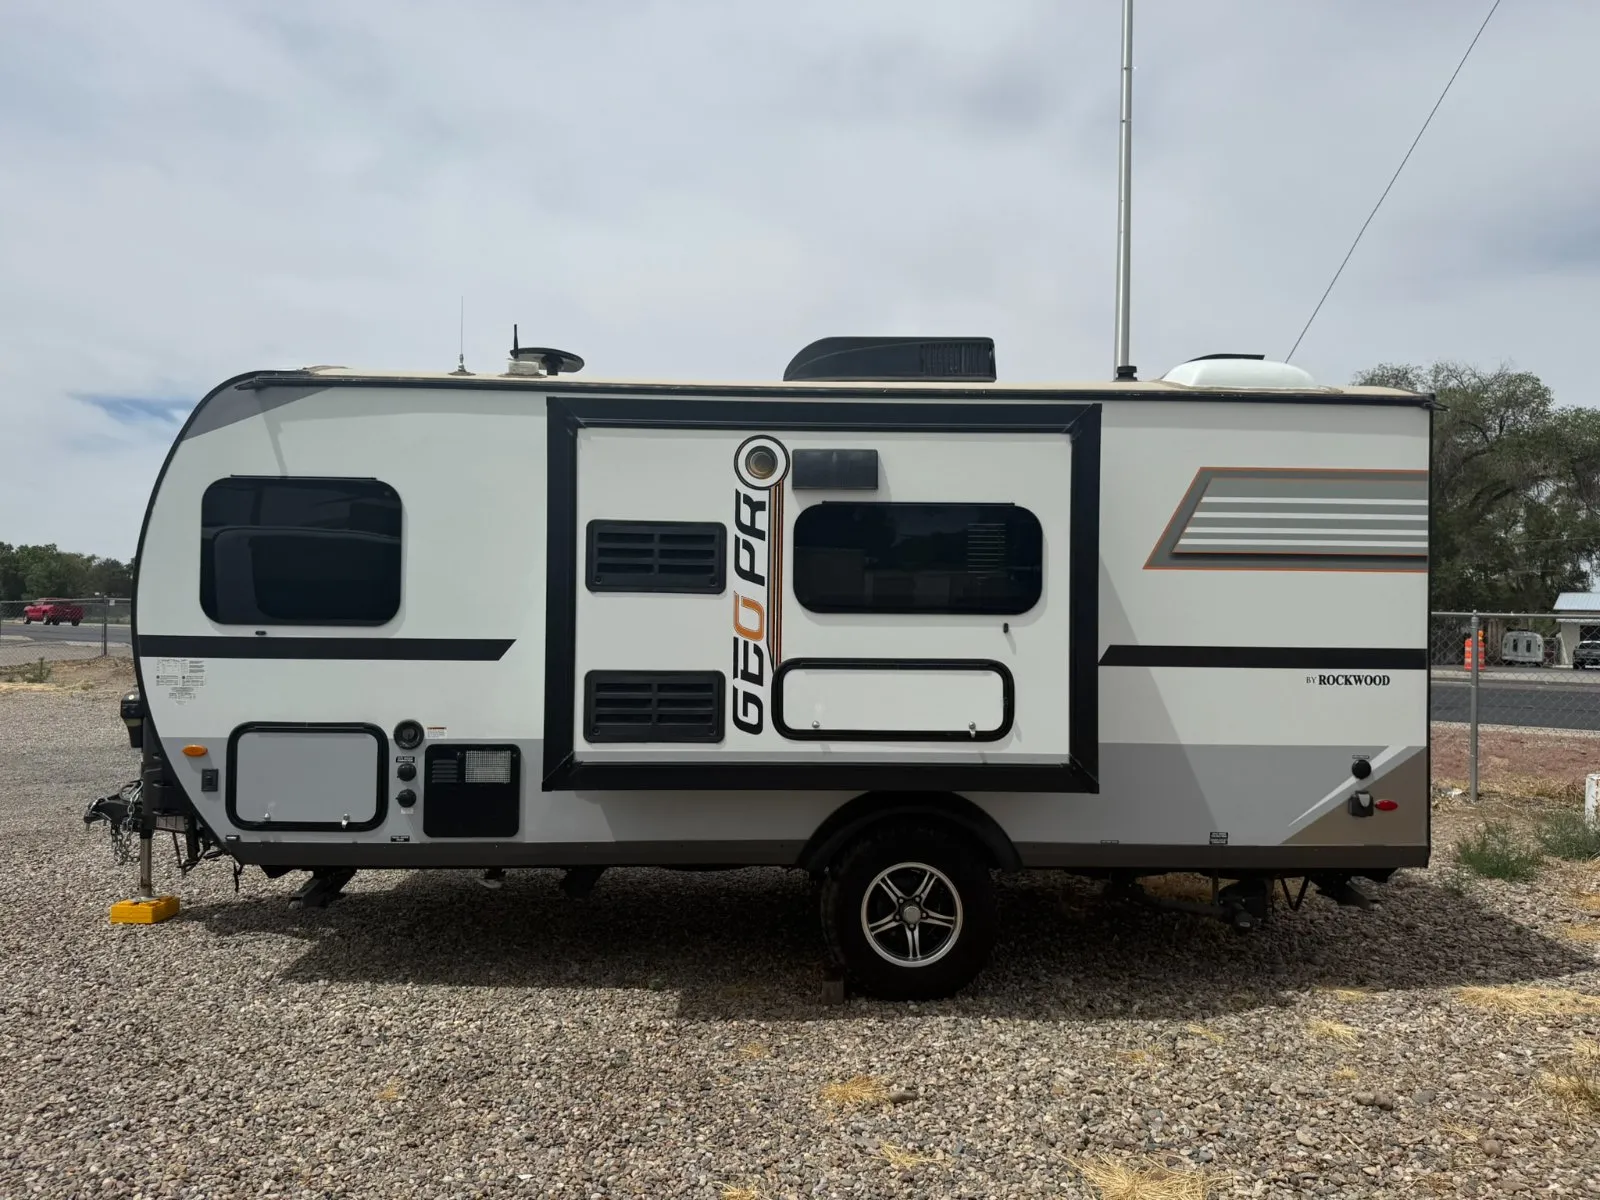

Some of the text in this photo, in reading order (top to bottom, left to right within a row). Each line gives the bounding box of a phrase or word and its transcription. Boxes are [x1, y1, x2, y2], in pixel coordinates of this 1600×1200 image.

[733, 590, 764, 735] GEO
[1306, 674, 1391, 686] BY ROCKWOOD
